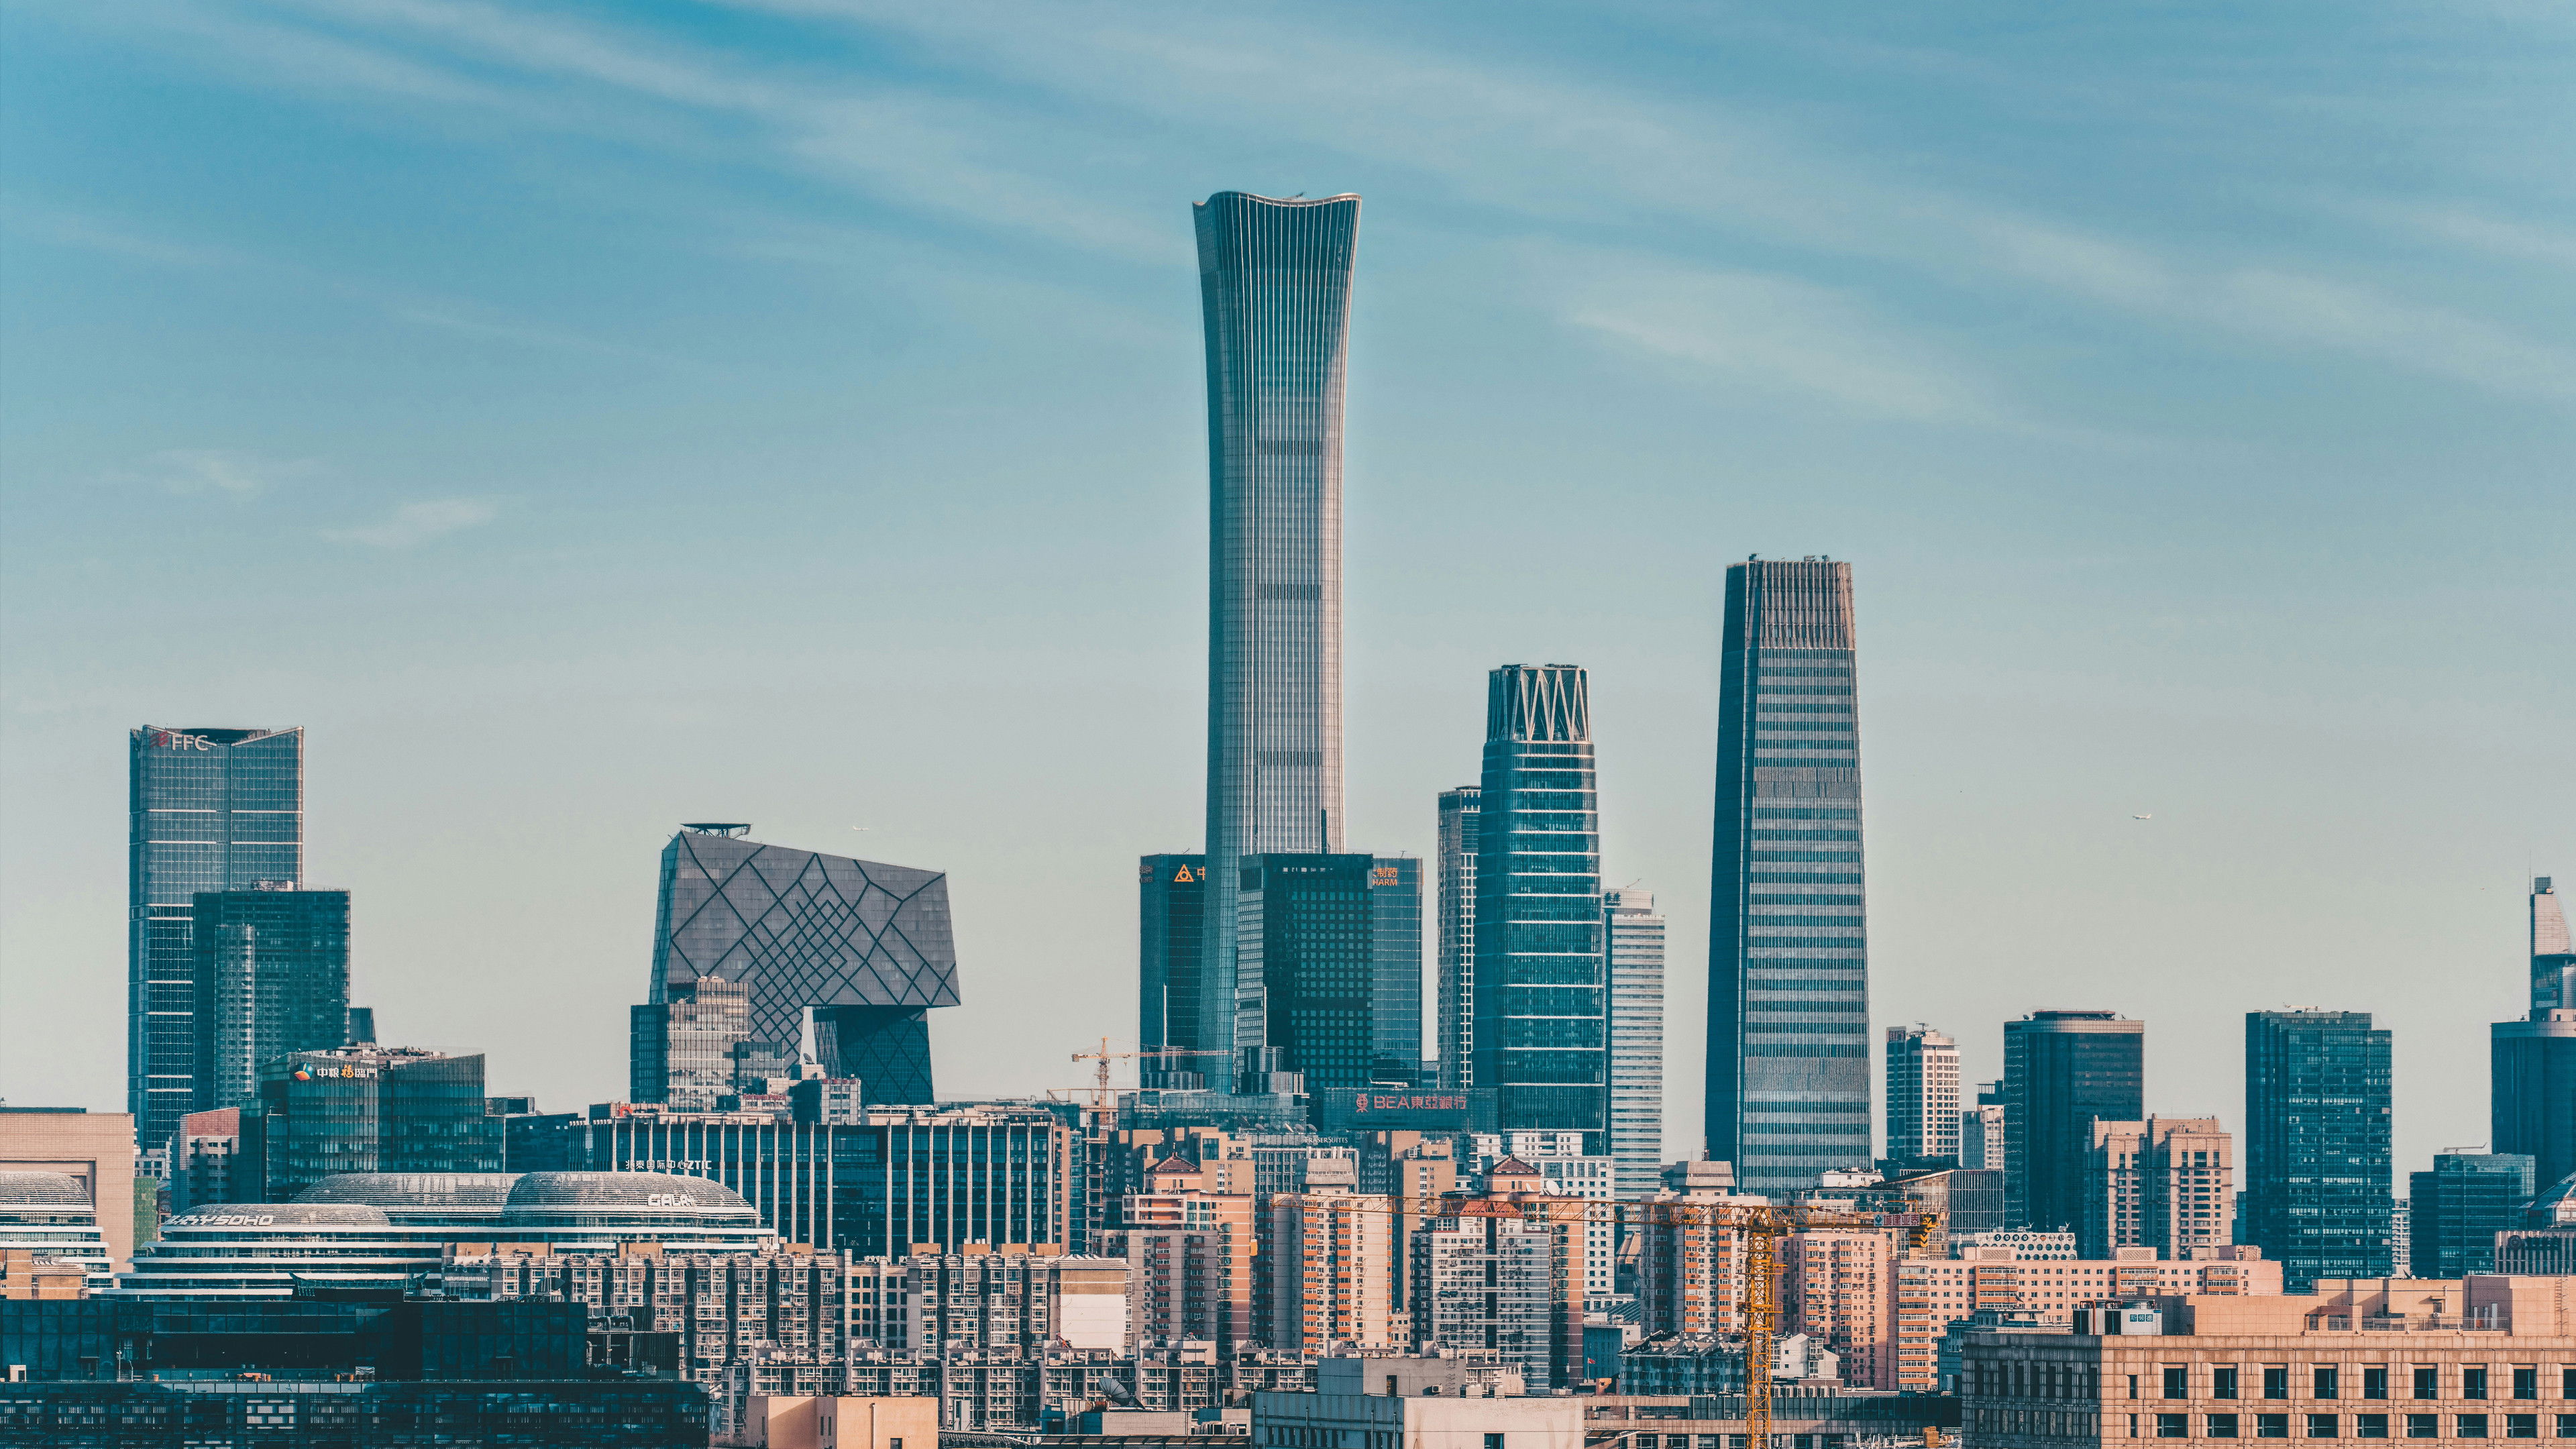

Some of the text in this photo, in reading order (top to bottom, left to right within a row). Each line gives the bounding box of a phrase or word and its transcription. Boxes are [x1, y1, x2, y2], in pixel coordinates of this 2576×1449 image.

[172, 735, 208, 751] FFC
[1373, 867, 1397, 877] 制药
[1884, 1214, 1919, 1226] 城建亚泰
